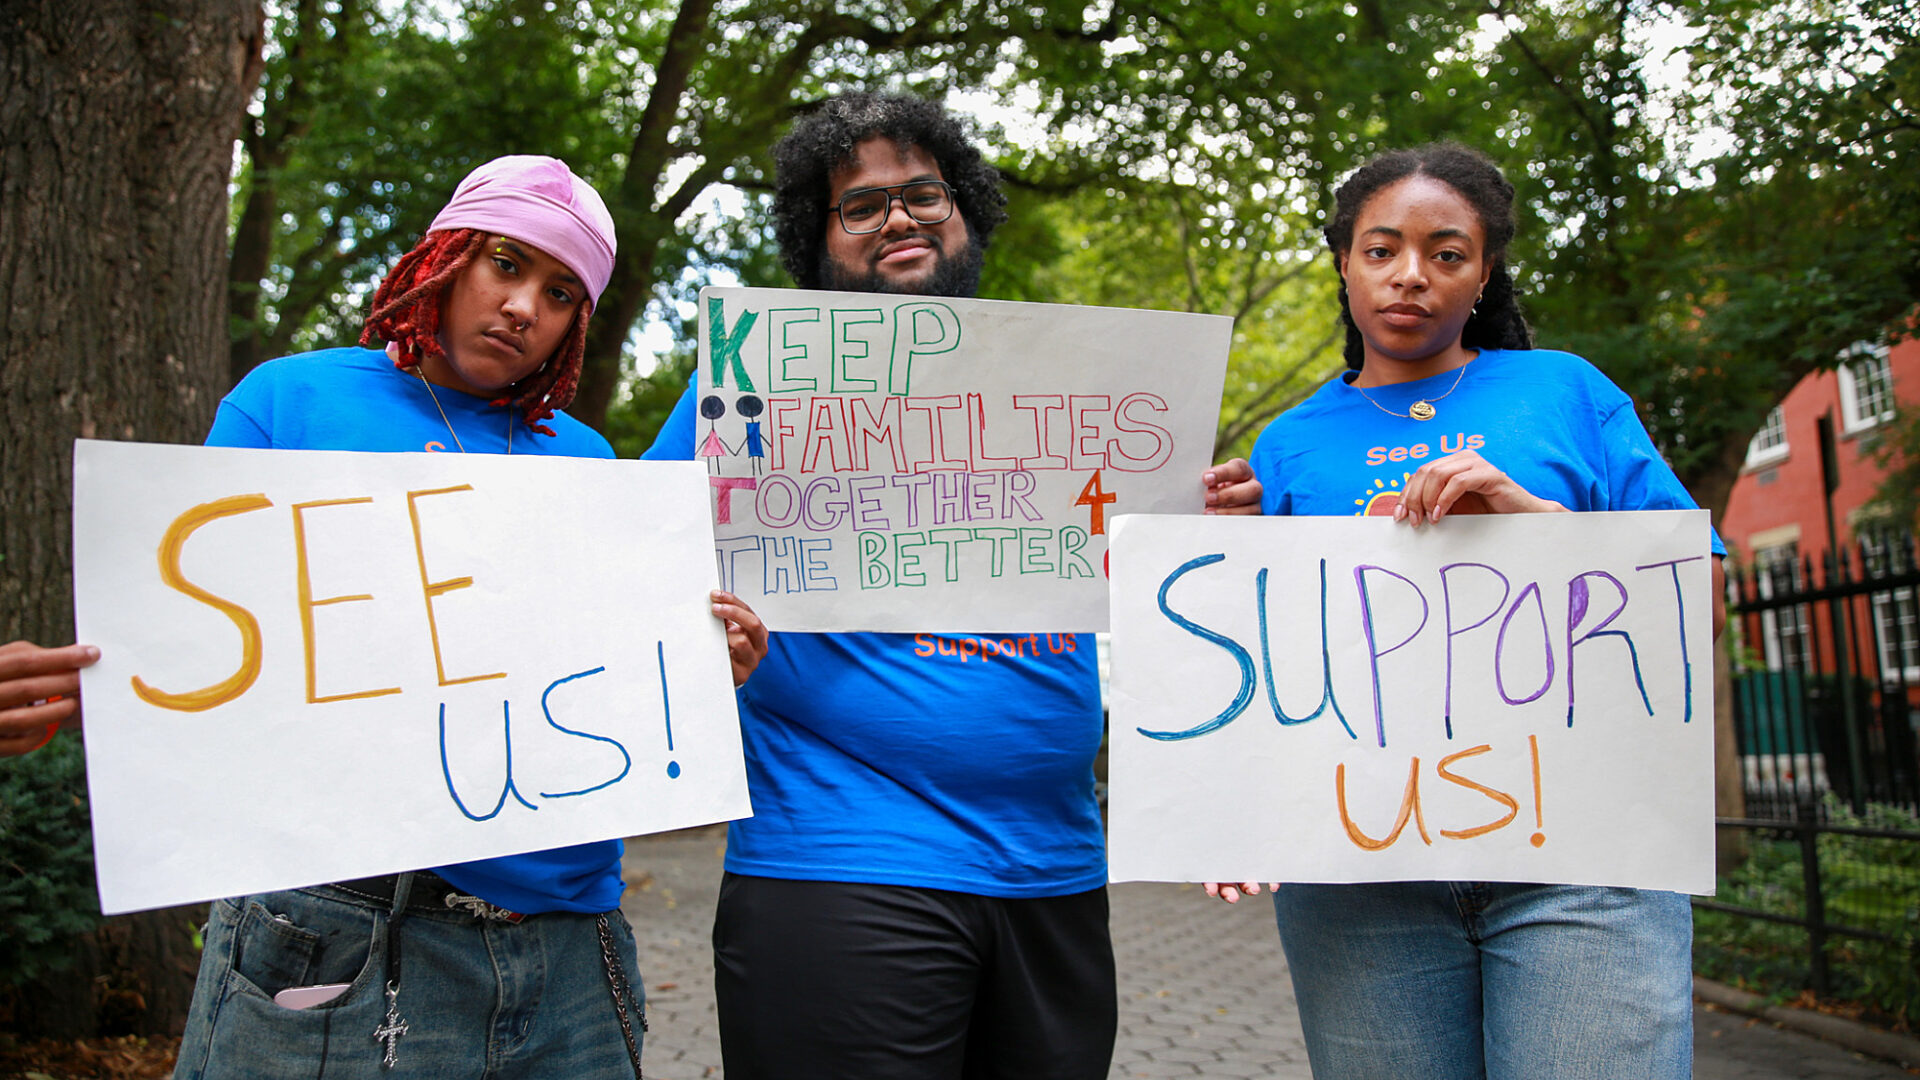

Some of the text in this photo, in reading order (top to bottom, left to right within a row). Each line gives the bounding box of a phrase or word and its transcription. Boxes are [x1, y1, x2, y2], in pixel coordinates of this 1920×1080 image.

[707, 296, 962, 396] KEEP
[768, 392, 1175, 473] FAMILIES
[1366, 433, 1486, 466] See Us
[708, 469, 1117, 535] TOGETHER 4
[131, 483, 508, 713] SEE
[715, 525, 1095, 596] THE BETTER
[914, 632, 1078, 662] Support Us
[1136, 554, 1705, 748] SUPPORT
